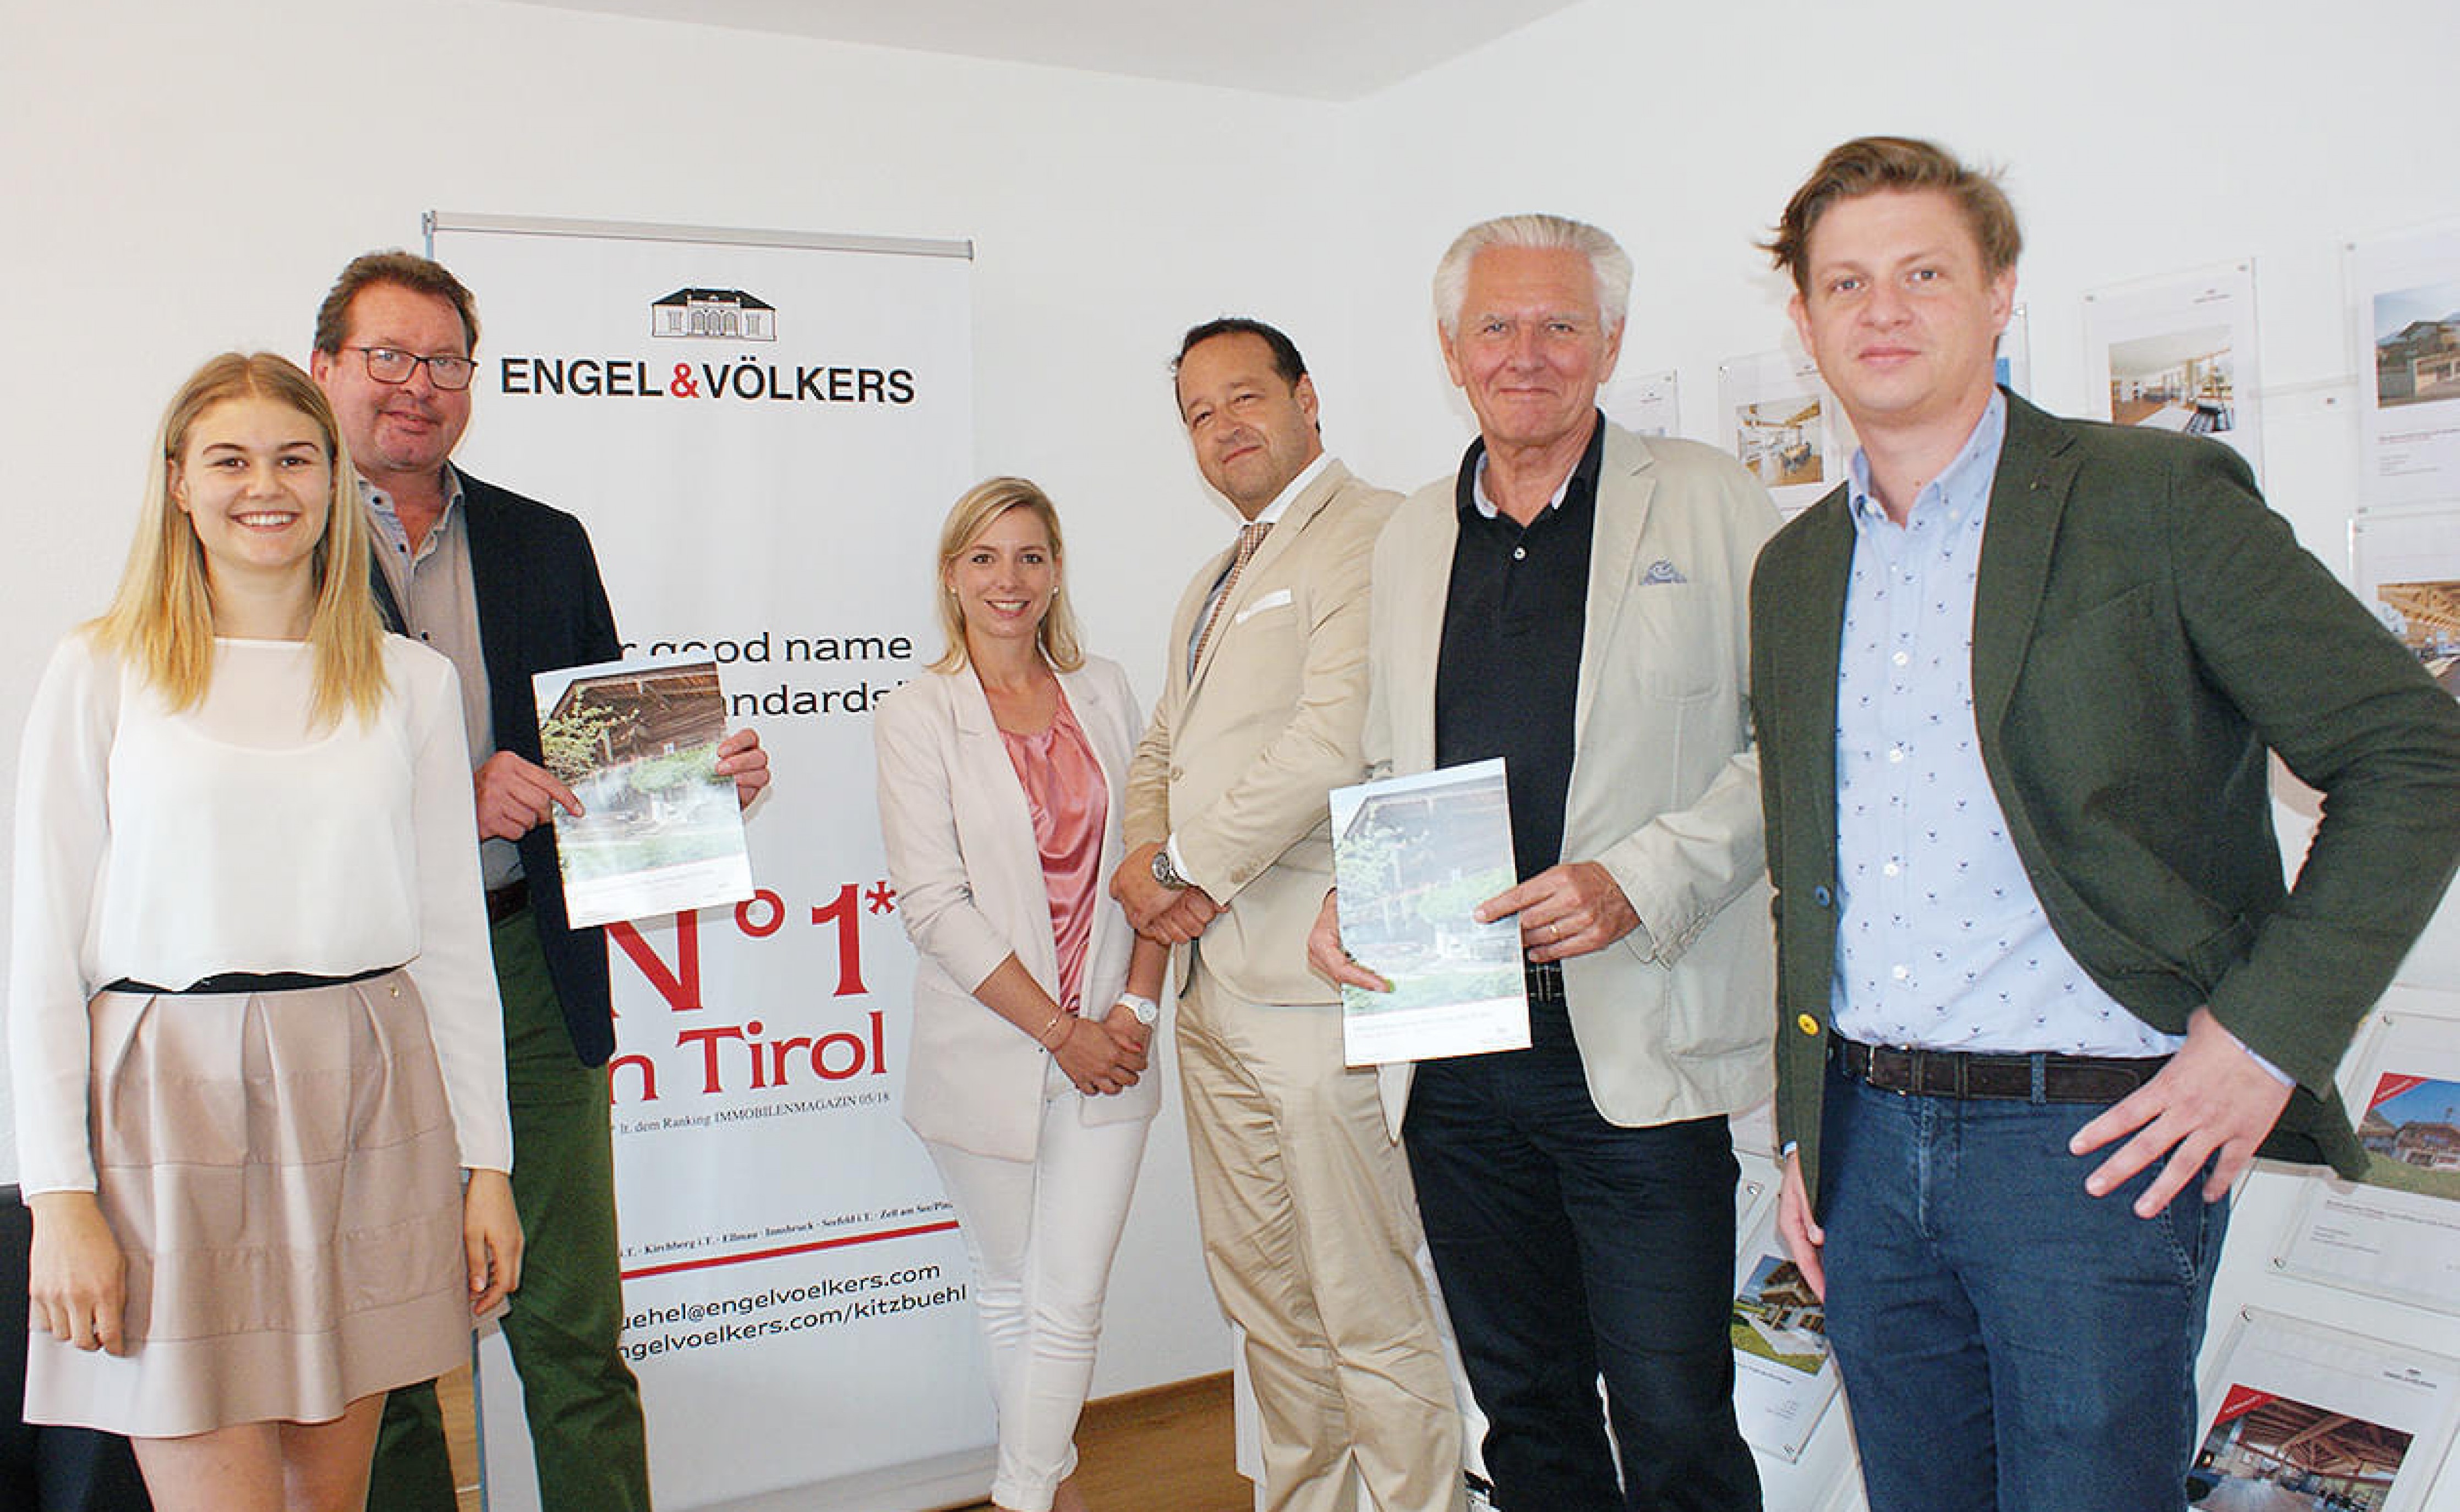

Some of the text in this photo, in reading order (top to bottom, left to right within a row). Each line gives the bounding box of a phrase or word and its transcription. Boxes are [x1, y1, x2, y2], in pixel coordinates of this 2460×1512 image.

[786, 636, 912, 661] name
[677, 1011, 887, 1093] Tirol
[663, 1115, 711, 1131] Ranking
